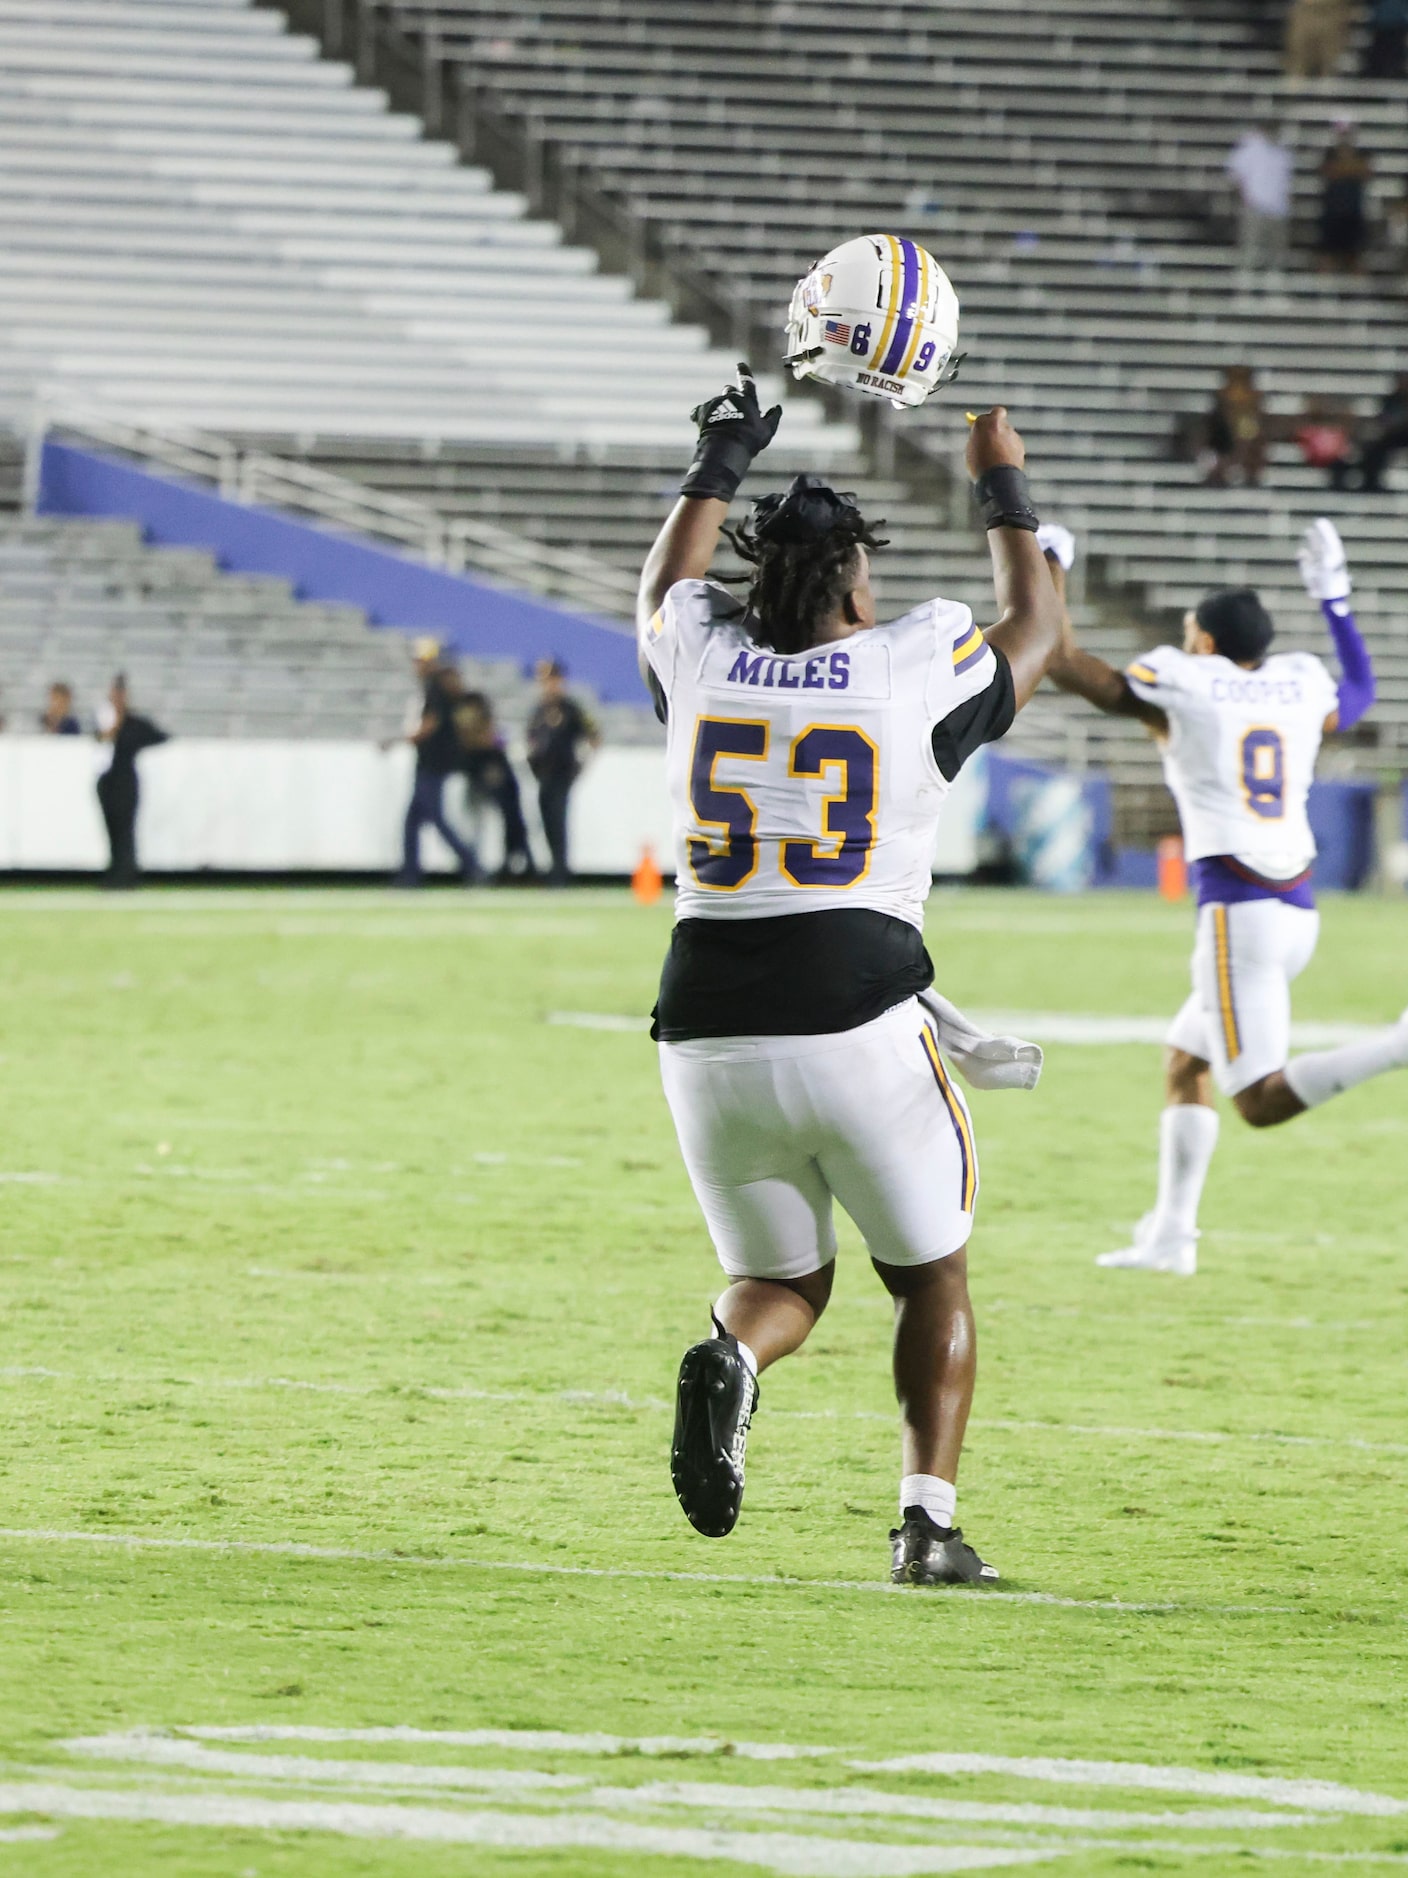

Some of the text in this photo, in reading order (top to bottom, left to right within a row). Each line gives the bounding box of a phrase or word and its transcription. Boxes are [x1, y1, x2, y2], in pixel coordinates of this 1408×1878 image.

[850, 322, 936, 372] 6 9
[856, 372, 906, 395] NO RACISM
[707, 411, 745, 424] adidas
[727, 651, 851, 690] MILES
[1212, 677, 1303, 705] COOPER
[686, 714, 880, 892] 53
